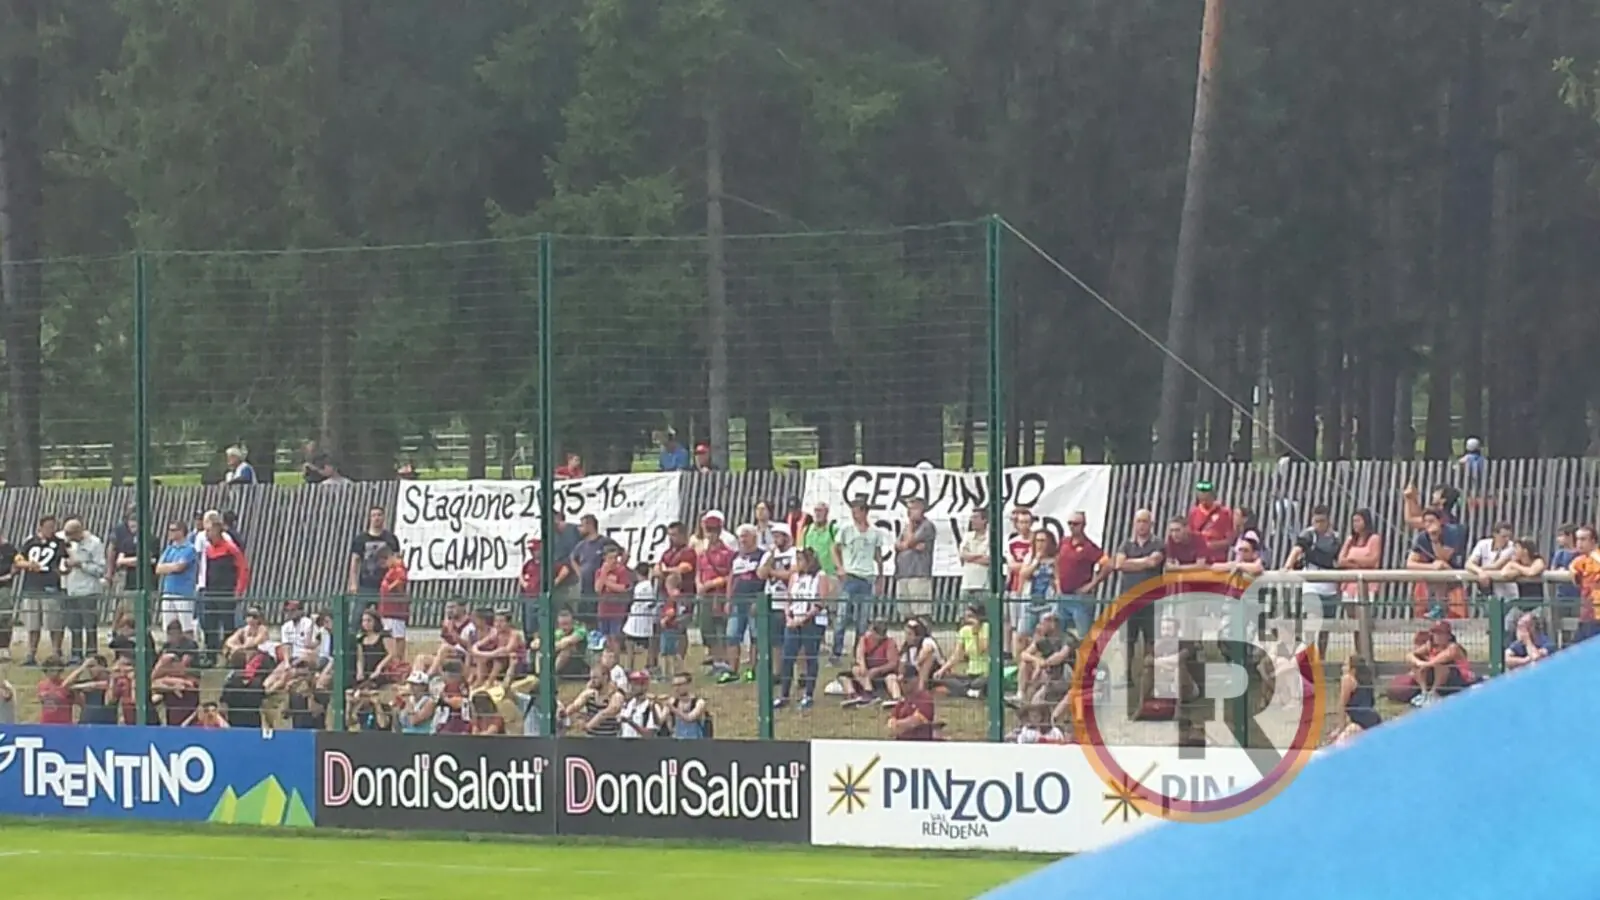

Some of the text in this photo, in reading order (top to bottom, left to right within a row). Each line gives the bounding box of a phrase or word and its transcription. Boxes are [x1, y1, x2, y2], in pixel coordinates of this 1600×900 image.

[403, 484, 515, 532] Stagione
[402, 535, 422, 570] in
[428, 536, 508, 571] CAMPO
[14, 737, 215, 808] TRENTINO
[882, 767, 1071, 822] PINZOLO
[922, 821, 989, 839] RENDENA
